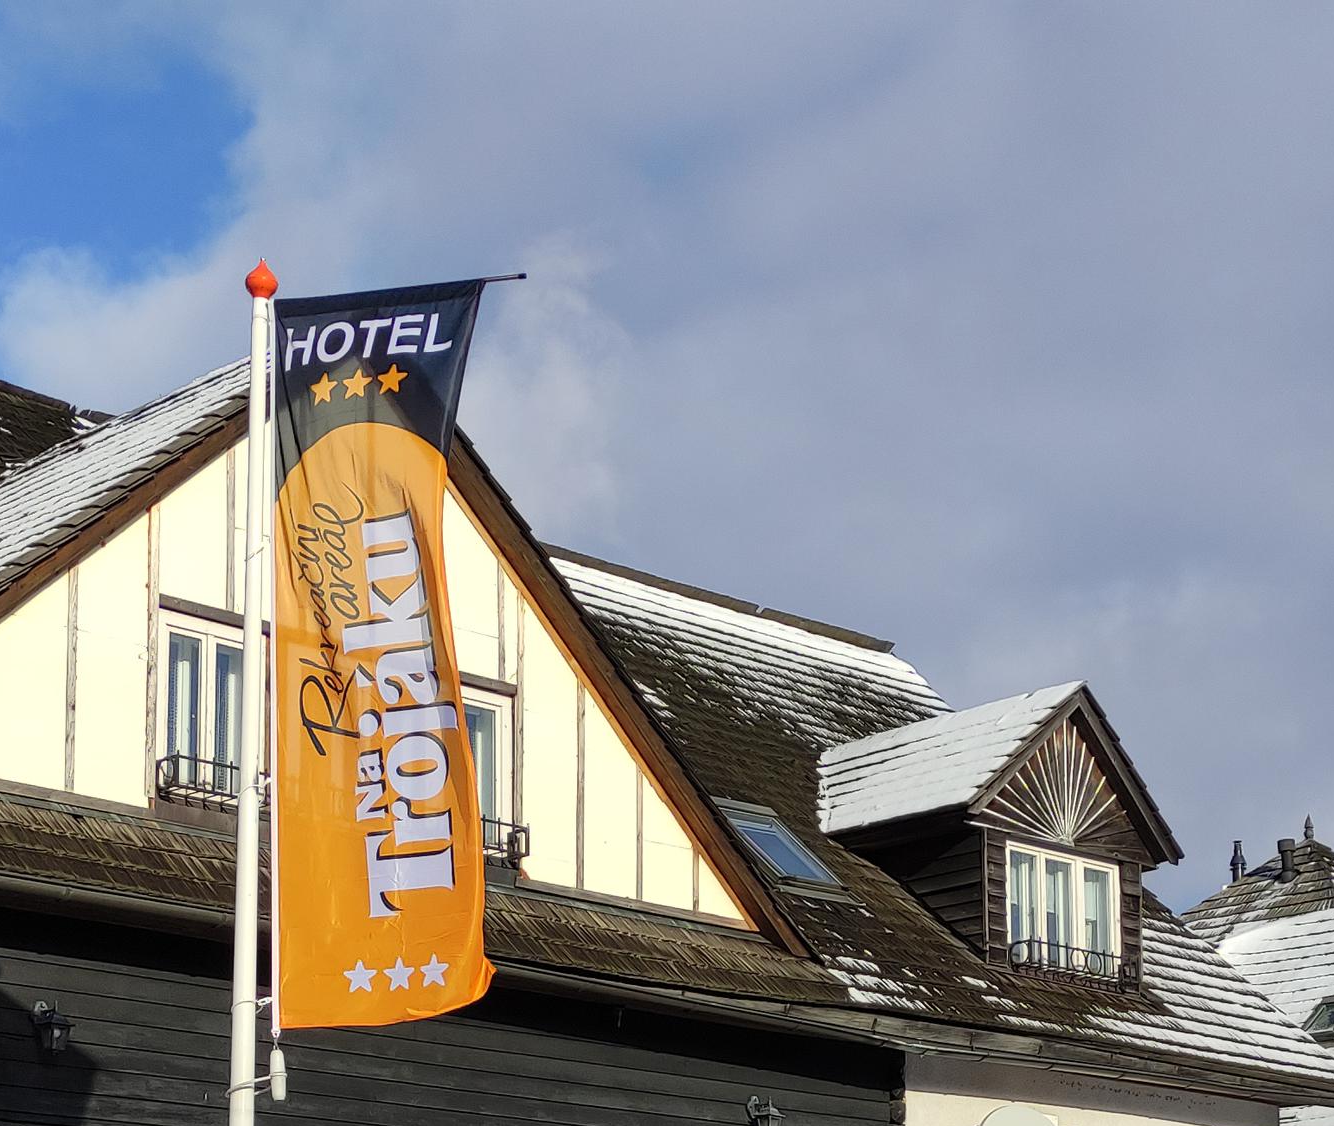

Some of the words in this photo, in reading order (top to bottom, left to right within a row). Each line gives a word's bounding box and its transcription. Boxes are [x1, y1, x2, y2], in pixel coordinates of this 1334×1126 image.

[284, 312, 453, 371] HOTEL
[312, 481, 364, 620] areál
[342, 508, 459, 919] Trojáku
[355, 748, 389, 822] Na
